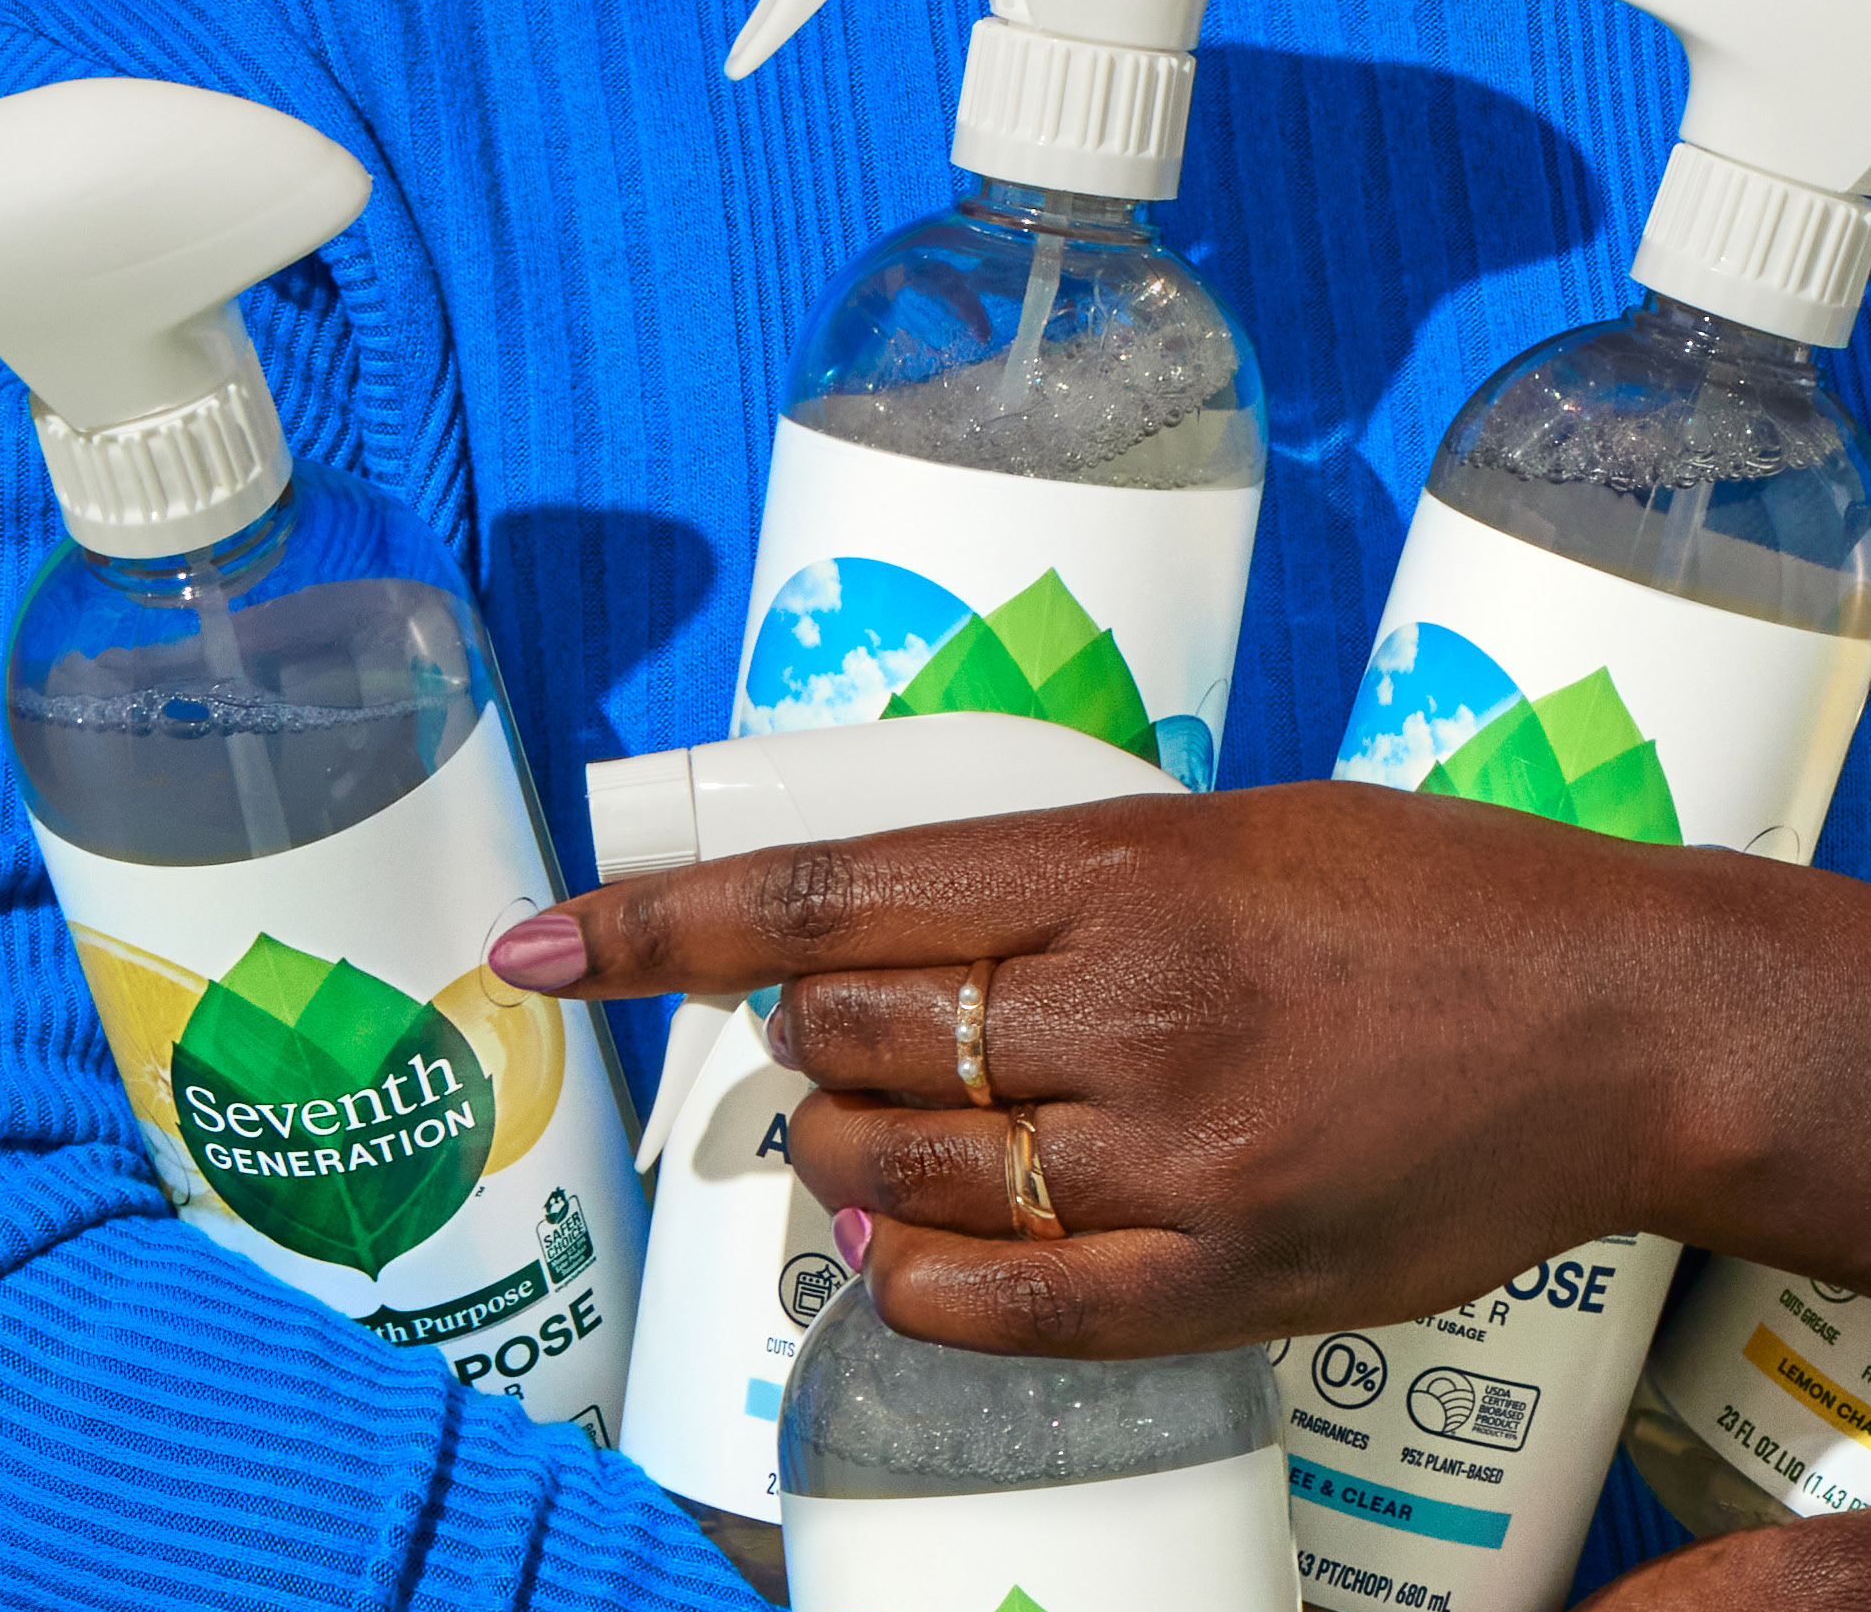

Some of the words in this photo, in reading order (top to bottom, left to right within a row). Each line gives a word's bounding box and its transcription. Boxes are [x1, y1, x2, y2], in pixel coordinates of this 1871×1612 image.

[185, 1053, 463, 1139] Seventh
[204, 1101, 476, 1178] GENERATION
[544, 1211, 582, 1249] SAFER
[547, 1222, 587, 1260] CHOICE
[412, 1279, 534, 1339] Purpose
[1779, 1288, 1804, 1317] CUTS
[1800, 1307, 1841, 1345] GREASE
[766, 1337, 795, 1357] CUTS
[1437, 1318, 1487, 1343] USAGE
[1321, 1343, 1380, 1392] 0%
[1776, 1357, 1838, 1410] LEMON
[1479, 1404, 1525, 1421] BIOBASED
[1481, 1395, 1527, 1411] CERTIFIED
[1485, 1385, 1511, 1398] USDA
[1290, 1408, 1370, 1450] FRAGRANCES
[1475, 1414, 1521, 1430] PRODUCT
[1400, 1447, 1423, 1467] 95%
[1424, 1453, 1504, 1484] PLANT-BASED
[1716, 1404, 1741, 1434] 23
[1734, 1419, 1757, 1450] FL
[1753, 1435, 1781, 1465] OZ
[1773, 1450, 1807, 1485] LIQ
[1802, 1472, 1848, 1511] (1.43
[1289, 1467, 1315, 1490] EE
[1320, 1479, 1335, 1497] &
[1341, 1487, 1413, 1521] CLEAR
[1315, 1557, 1393, 1604] PT/CHOP)
[1395, 1582, 1428, 1608] 680
